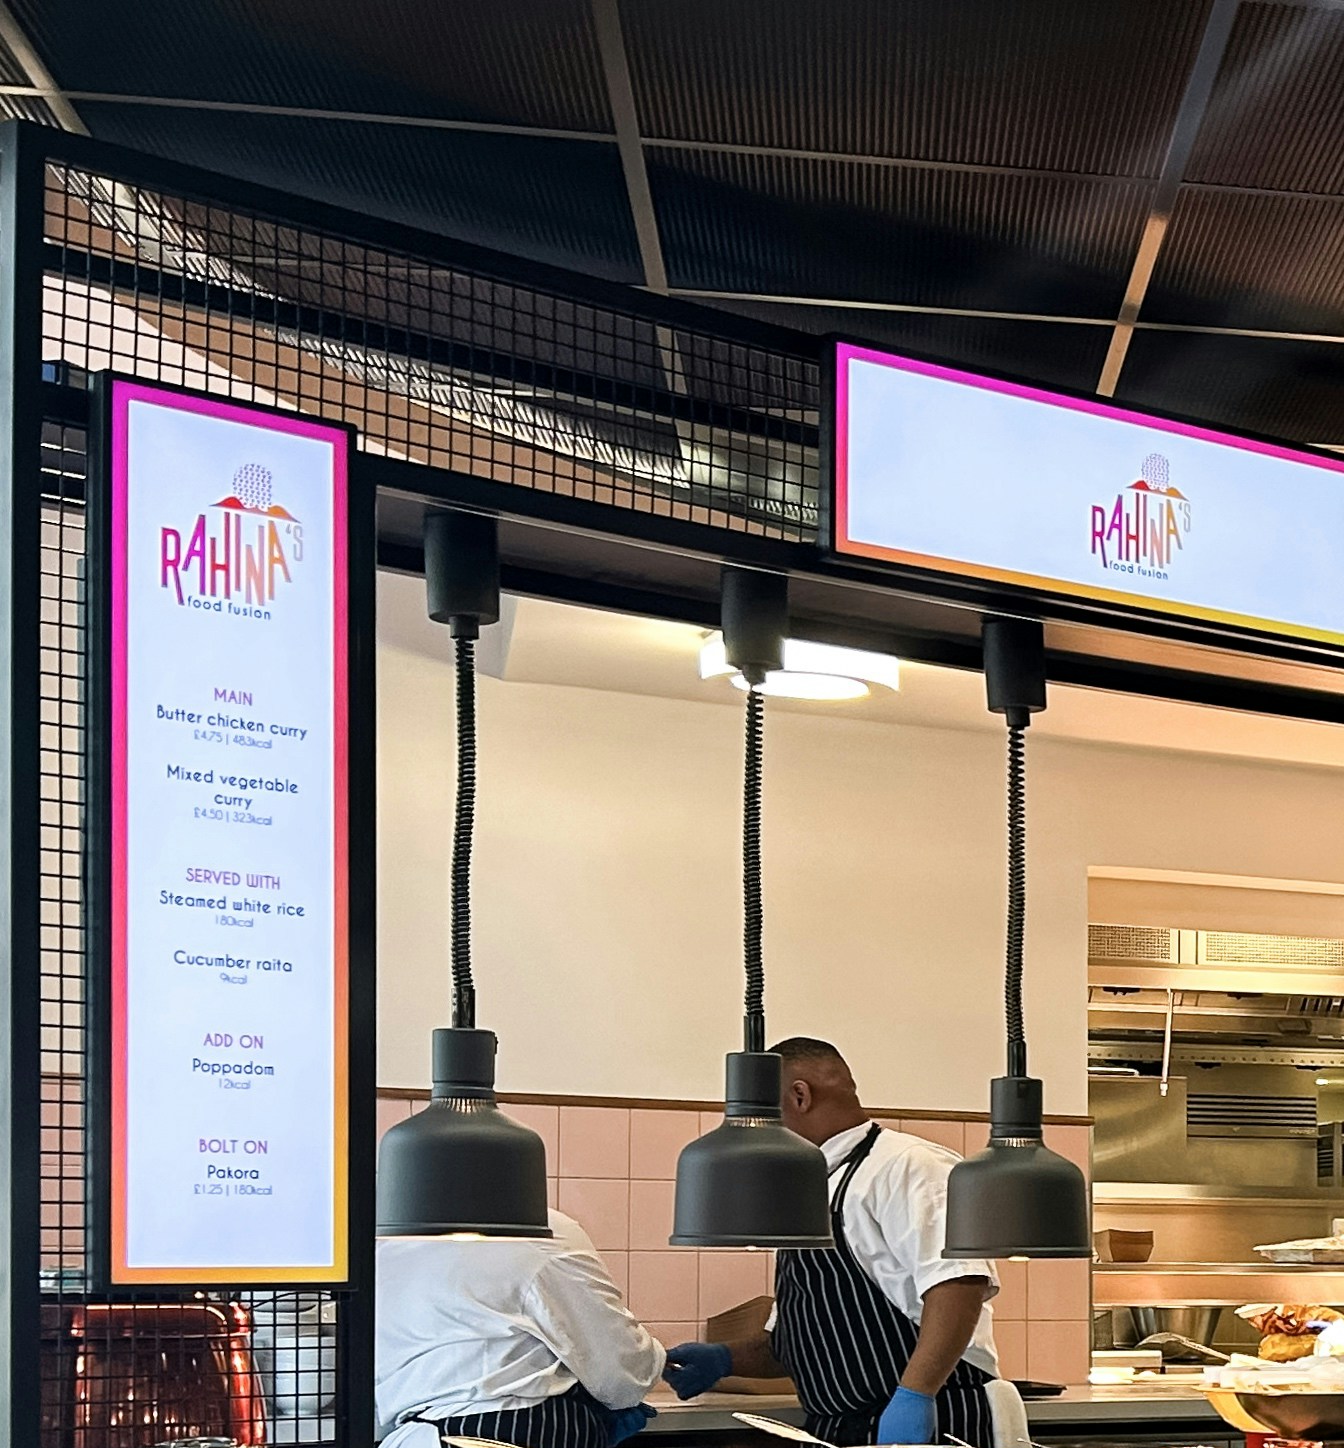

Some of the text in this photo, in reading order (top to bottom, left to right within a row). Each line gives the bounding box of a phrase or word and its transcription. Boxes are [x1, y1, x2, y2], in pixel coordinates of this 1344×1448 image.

[1109, 560, 1169, 580] food fusion
[187, 596, 271, 620] food fusion
[214, 687, 253, 706] MAIN
[157, 704, 307, 741] Butter chicken curry
[167, 764, 299, 794] Mixed vegetable
[214, 794, 253, 810] curry
[186, 867, 280, 890] SERVED WITH
[159, 890, 306, 917] Steamed white rice
[174, 950, 293, 972] Cucumber raita
[203, 1033, 264, 1049] ADD ON
[192, 1057, 275, 1076] Poppadom
[199, 1139, 269, 1155] BOLT ON
[207, 1164, 260, 1180] Pakora
